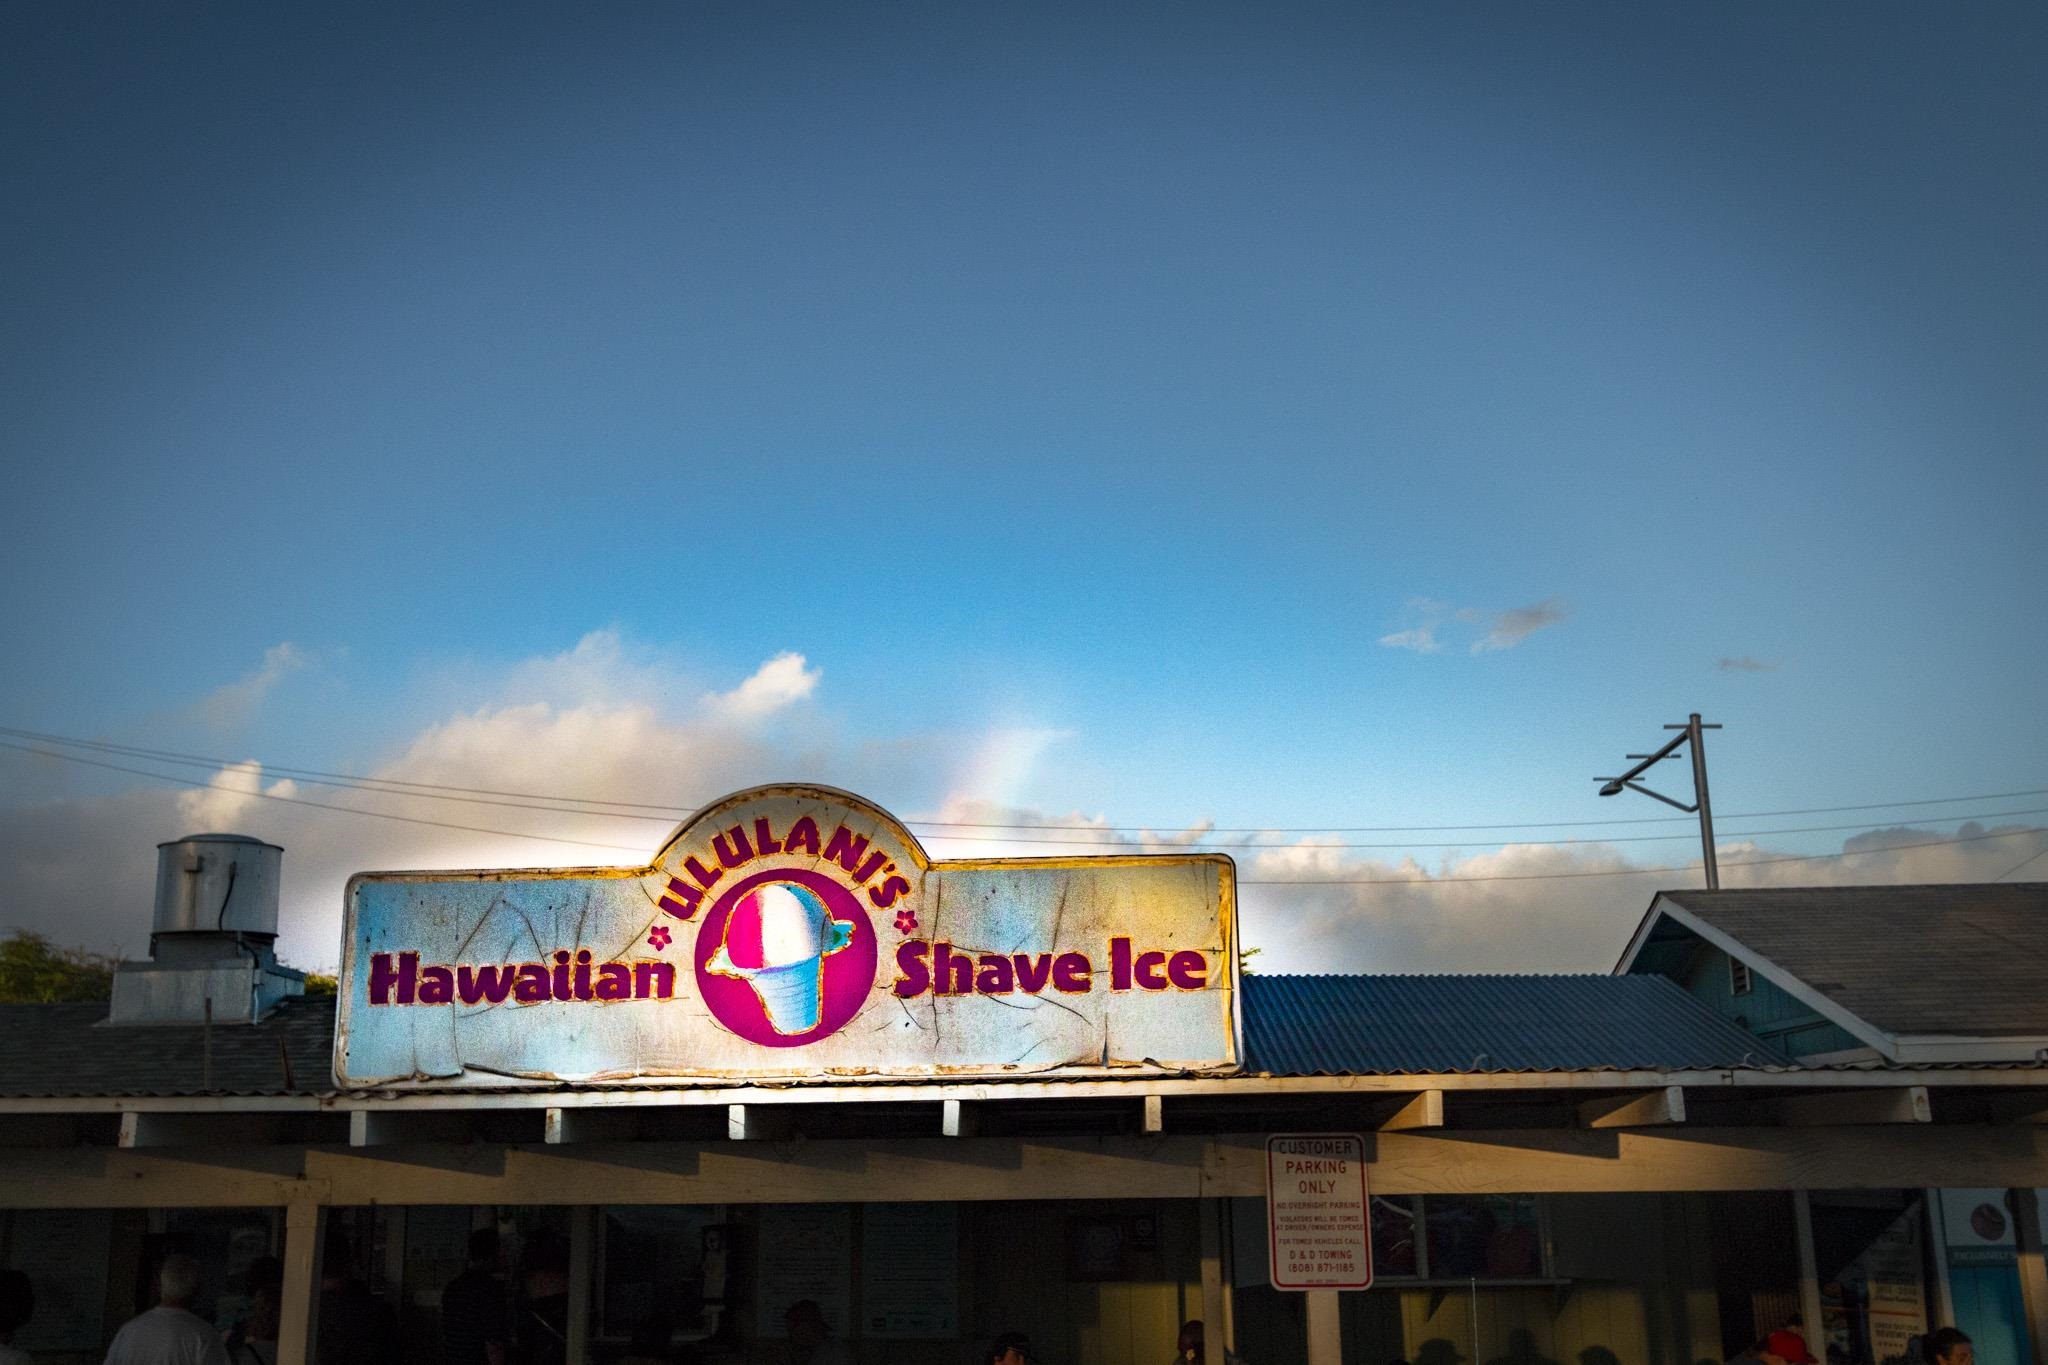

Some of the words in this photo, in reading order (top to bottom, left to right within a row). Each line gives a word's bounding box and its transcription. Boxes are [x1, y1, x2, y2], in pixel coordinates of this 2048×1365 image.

[369, 949, 676, 1005] Hawaiian
[893, 940, 1093, 997] Shave
[1110, 937, 1208, 991] Ice
[1279, 1141, 1352, 1154] CUSTOMER
[1286, 1160, 1346, 1174] PARKING
[1299, 1180, 1336, 1194] ONLY
[1276, 1201, 1287, 1209] NO
[1288, 1201, 1328, 1209] OVERNIGHT
[1329, 1201, 1361, 1209] PARKING
[1289, 1250, 1296, 1260] D
[1299, 1250, 1306, 1260] &
[1309, 1250, 1316, 1260] D
[1319, 1250, 1353, 1260] TOWING
[1288, 1263, 1314, 1273] (808)
[1317, 1263, 1356, 1273] 871-1185
